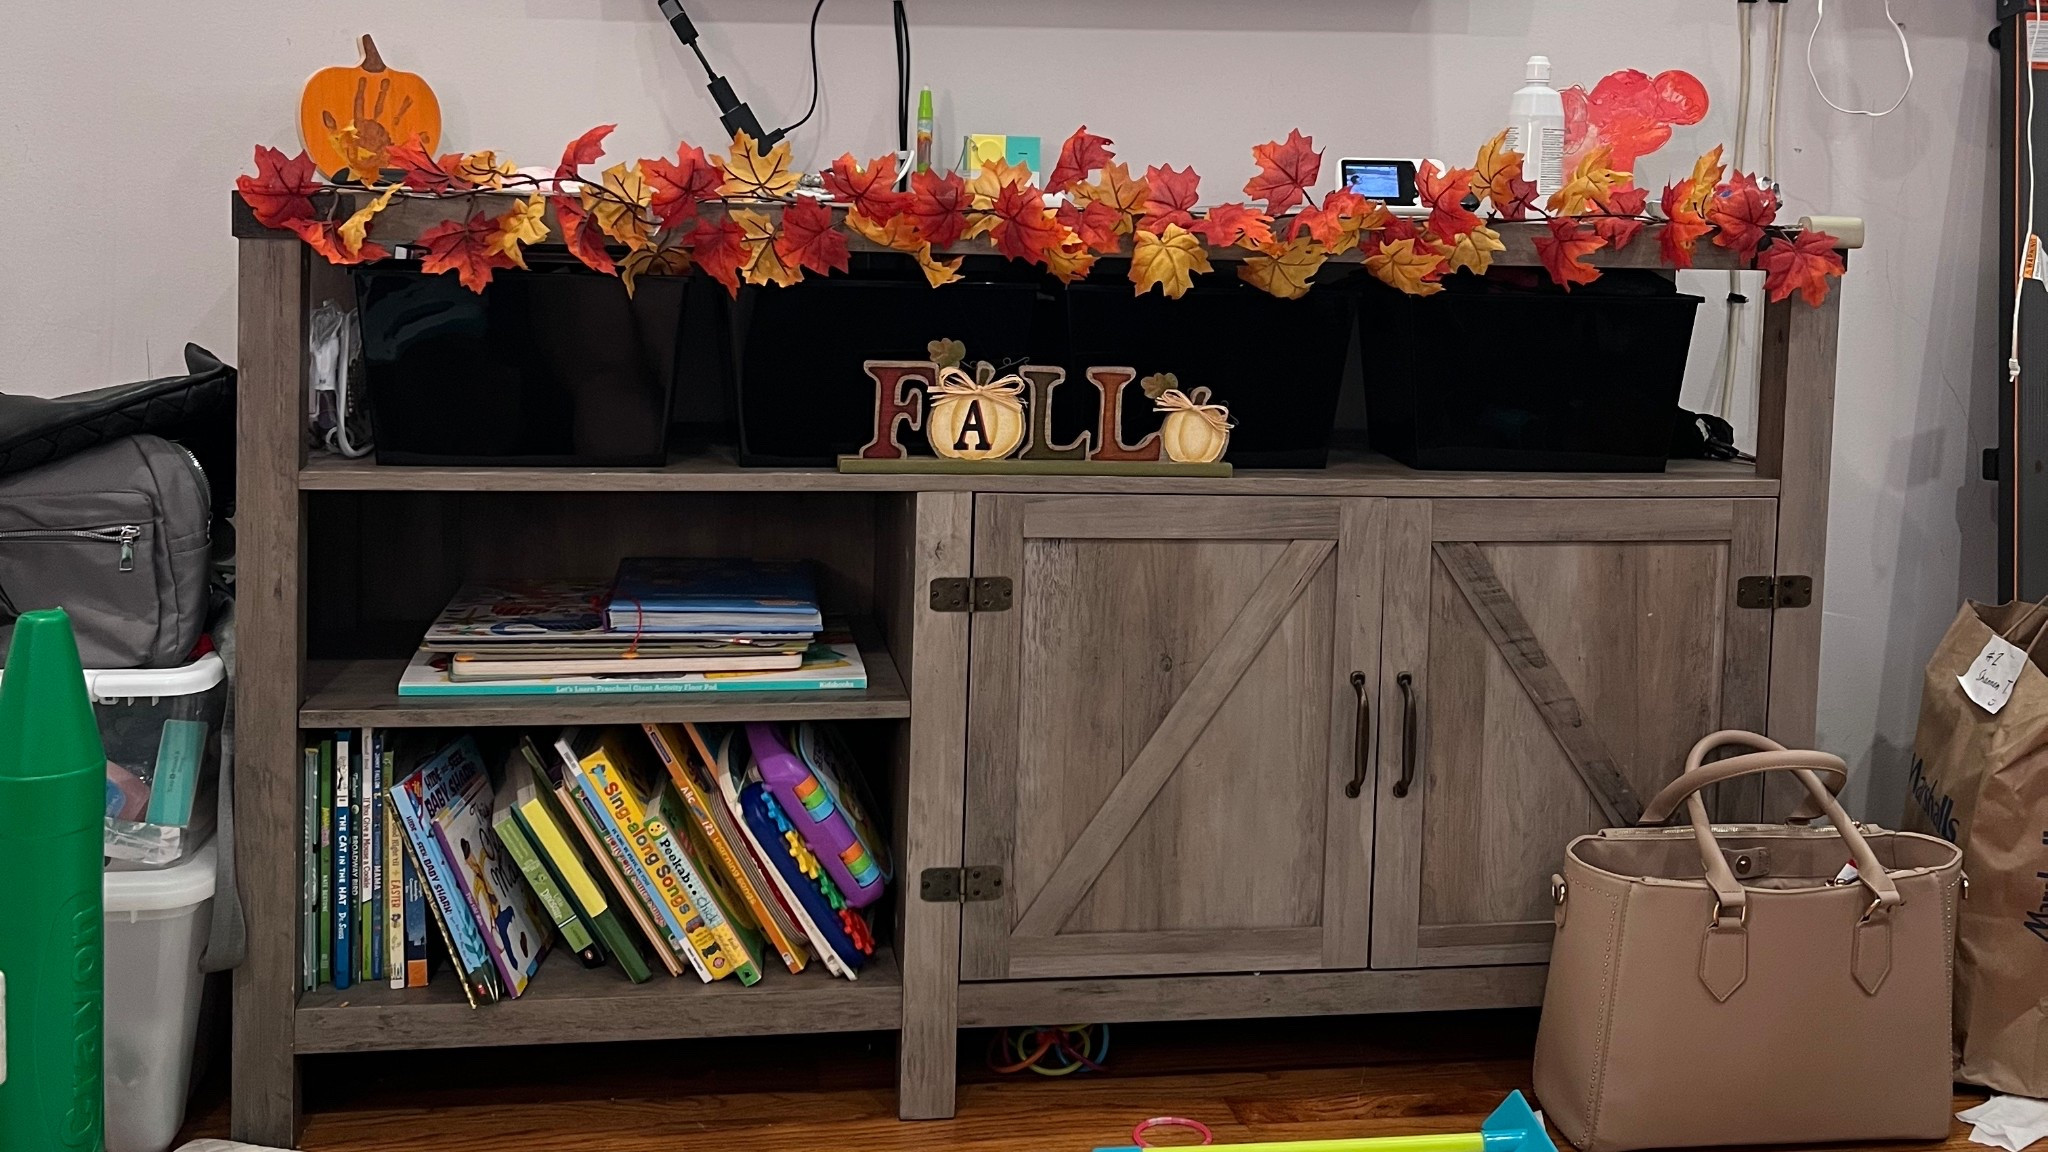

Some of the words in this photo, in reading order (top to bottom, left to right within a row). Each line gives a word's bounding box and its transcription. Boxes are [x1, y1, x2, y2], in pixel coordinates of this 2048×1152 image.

[864, 360, 1160, 462] FALL
[596, 684, 632, 692] Preschool
[633, 684, 653, 692] Giant
[654, 684, 683, 693] Activity
[683, 683, 703, 691] Floor
[704, 683, 717, 691] Pad
[338, 814, 346, 831] THE
[680, 786, 696, 804] ABC
[702, 820, 715, 835] 123
[713, 837, 741, 878] Learning
[338, 835, 347, 853] CAT
[351, 835, 359, 877] BROADWAY
[604, 781, 660, 866] Sing-along
[656, 864, 690, 915] Songs
[338, 856, 346, 865] IN
[422, 857, 439, 883] BABY
[338, 867, 346, 883] THE
[351, 878, 359, 896] BIRD
[363, 866, 371, 889] Cookie
[374, 865, 382, 890] MAMA
[338, 886, 347, 905] HAT
[390, 879, 401, 908] EASTER
[539, 887, 563, 922] Dinosaur
[697, 896, 721, 924] Chick
[338, 922, 347, 939] Seuss
